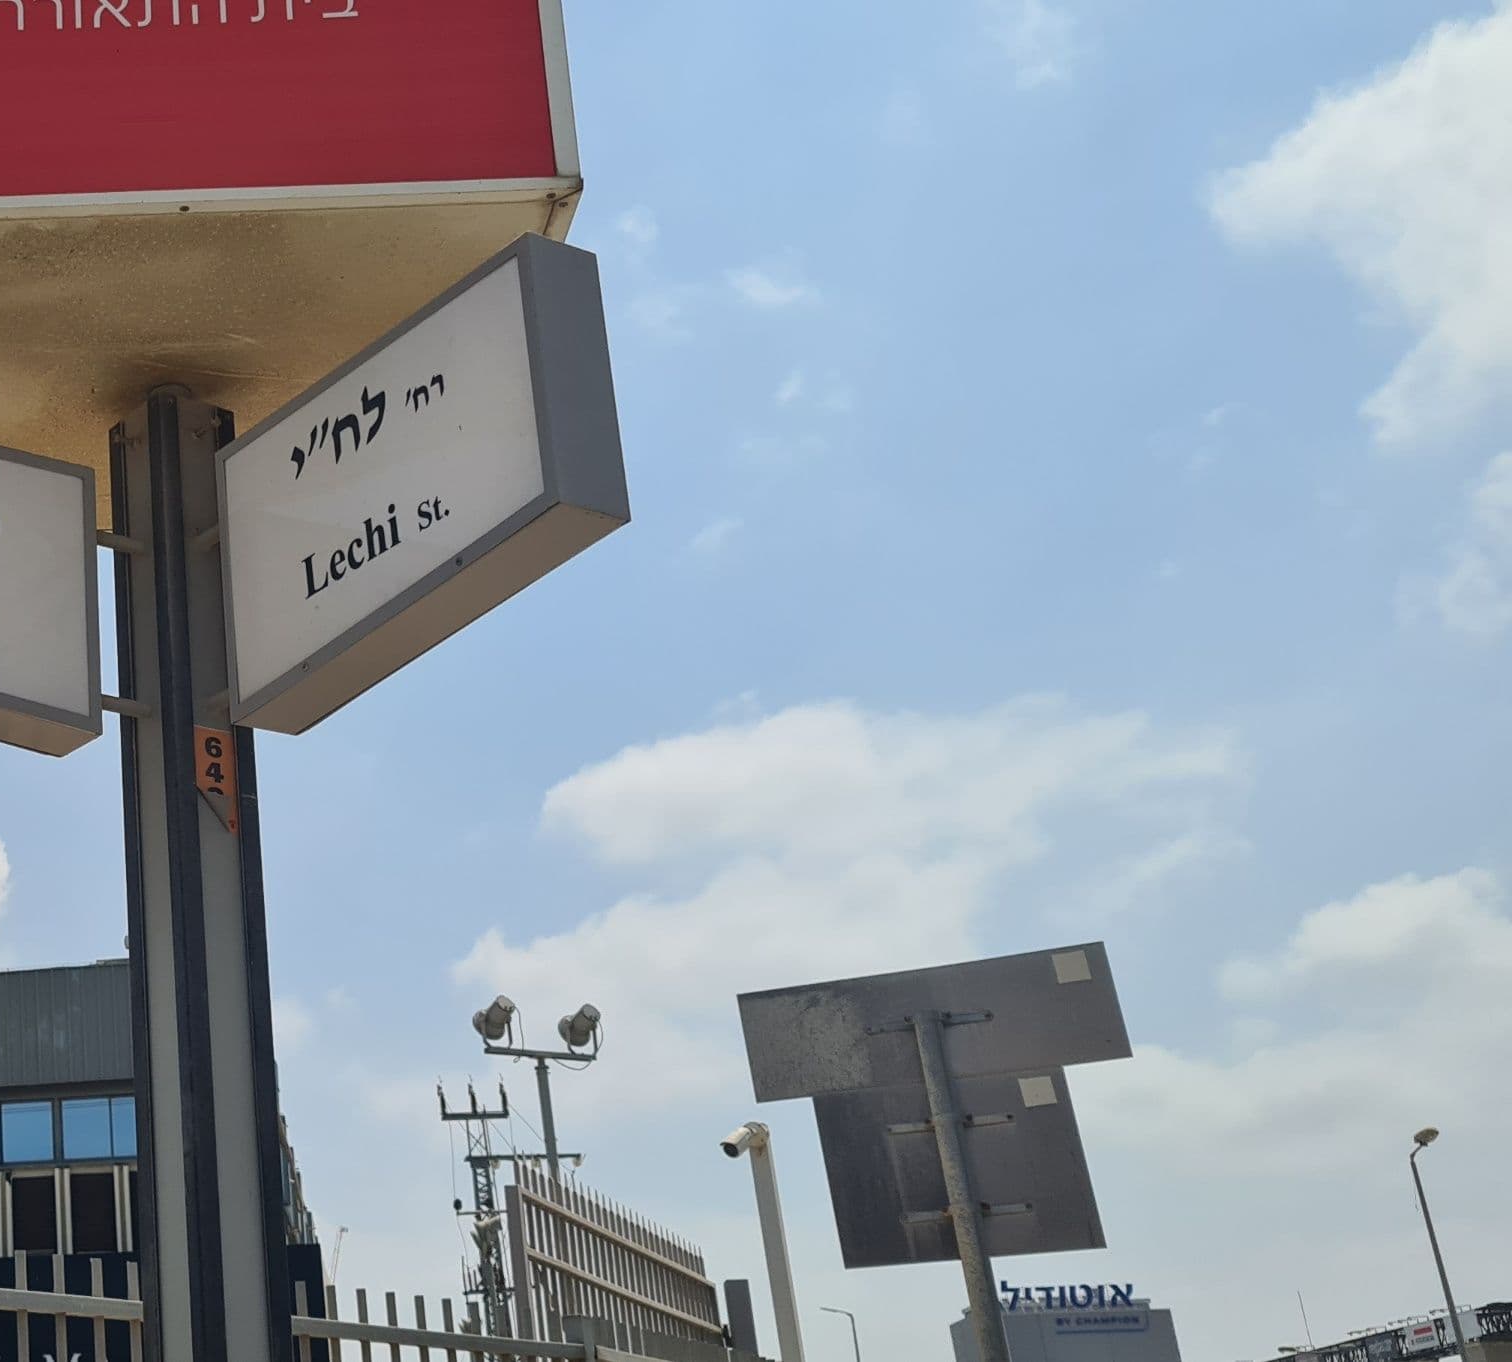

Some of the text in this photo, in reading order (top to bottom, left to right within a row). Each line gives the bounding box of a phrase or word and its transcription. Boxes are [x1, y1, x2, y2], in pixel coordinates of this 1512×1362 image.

[302, 496, 451, 600] Lechi St.
[204, 736, 225, 796] 64
[1000, 1280, 1134, 1311] אוטודיל
